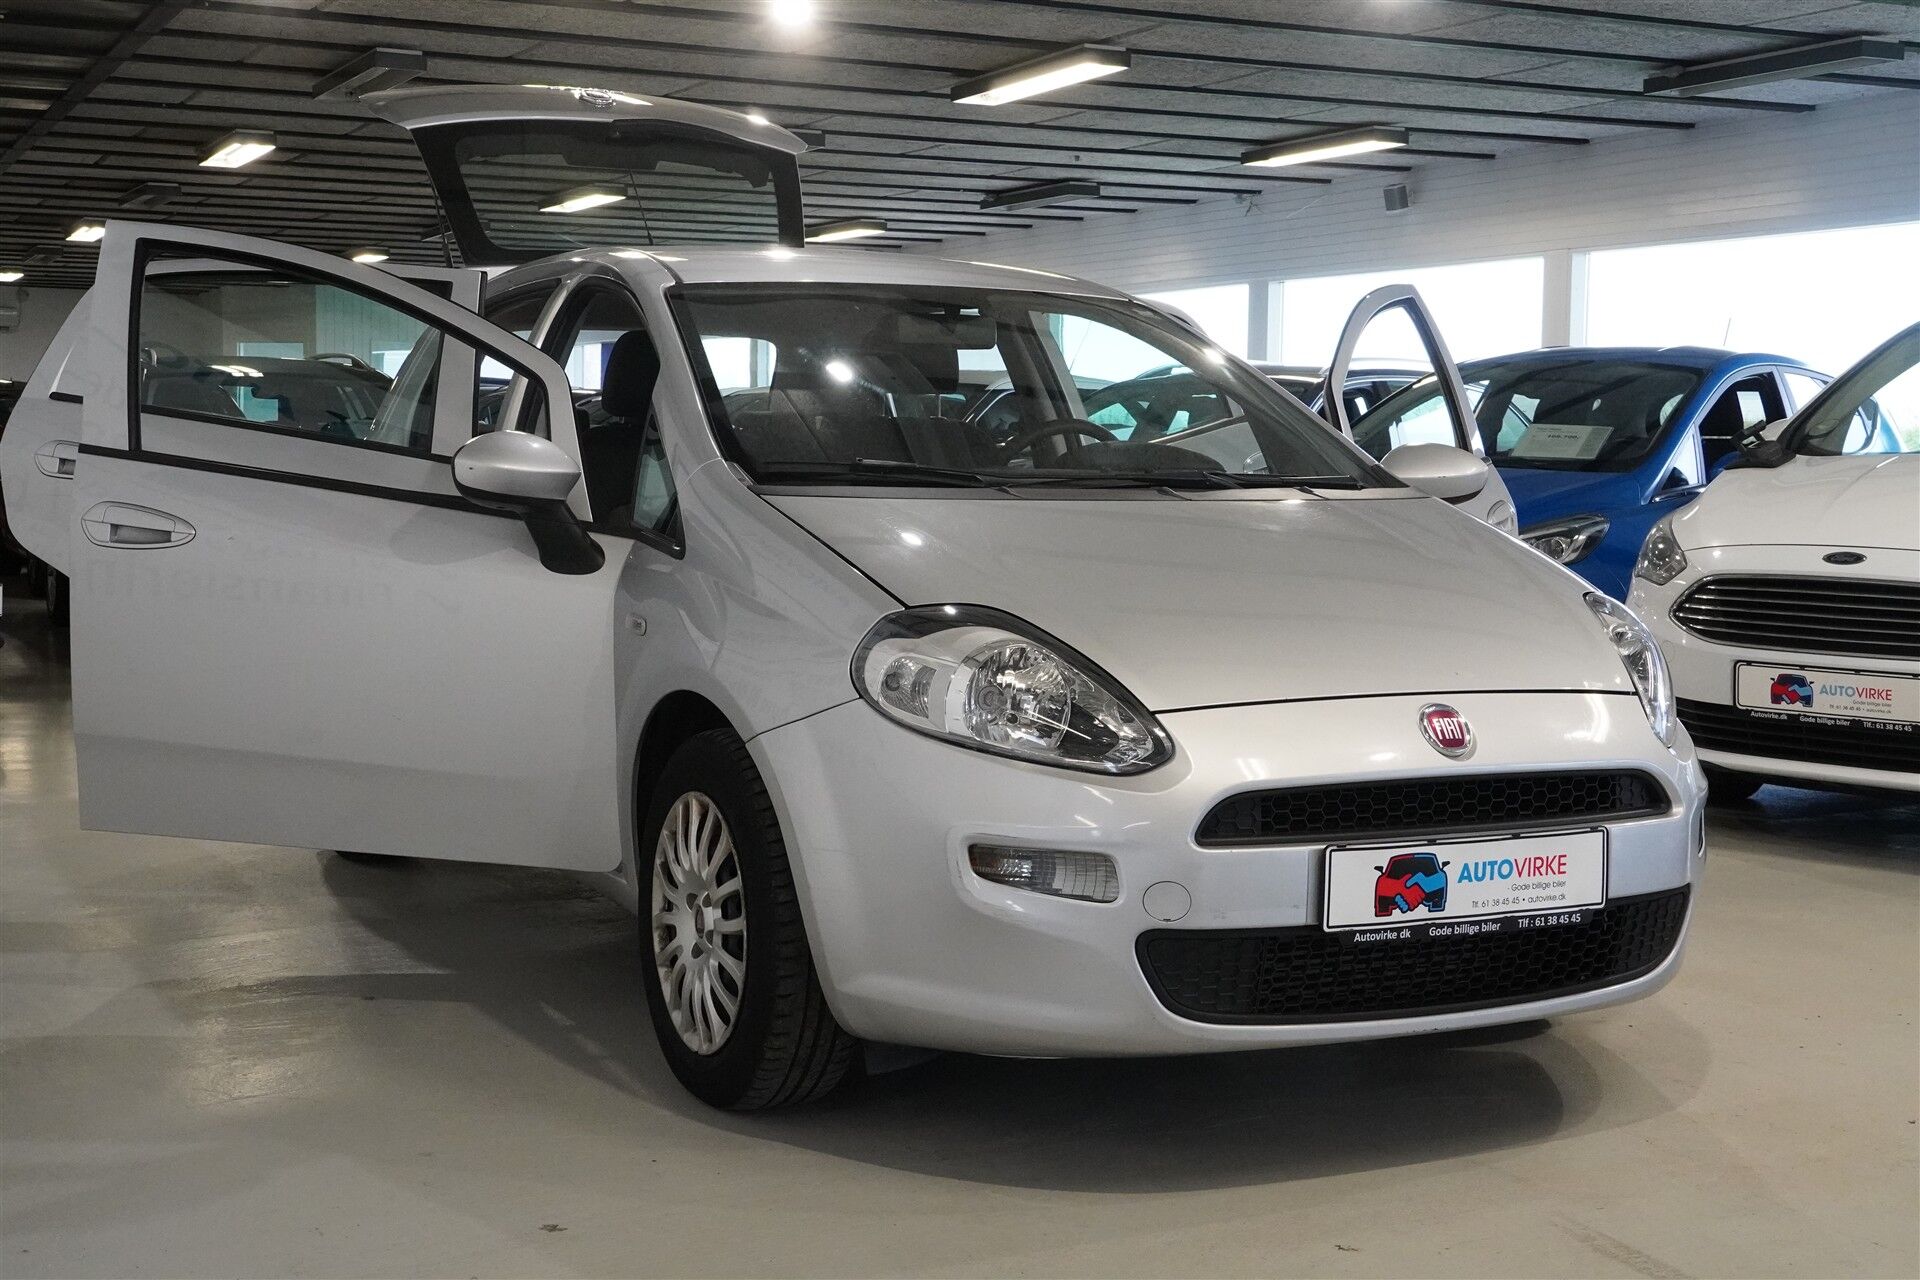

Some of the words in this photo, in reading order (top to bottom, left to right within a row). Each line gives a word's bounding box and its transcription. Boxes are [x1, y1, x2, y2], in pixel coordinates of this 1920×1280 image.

[1819, 684, 1892, 701] AUTOVIRKE
[1432, 717, 1463, 740] FIAT
[1799, 715, 1816, 723] Gode
[1816, 716, 1835, 726] billige
[1836, 718, 1850, 727] biler
[1876, 722, 1884, 730] 61
[1457, 854, 1568, 884] AUTOVIRKE
[1510, 883, 1531, 892] Gode
[1481, 899, 1489, 908] 61
[1492, 898, 1500, 907] 38
[1502, 897, 1510, 906] 45
[1511, 896, 1520, 905] 45
[1428, 925, 1453, 937] Gode
[1453, 922, 1480, 936] billige
[1481, 921, 1501, 933] biler
[1535, 916, 1546, 927] 61
[1546, 915, 1558, 926] 38
[1558, 914, 1570, 925] 45
[1570, 913, 1582, 924] 45
